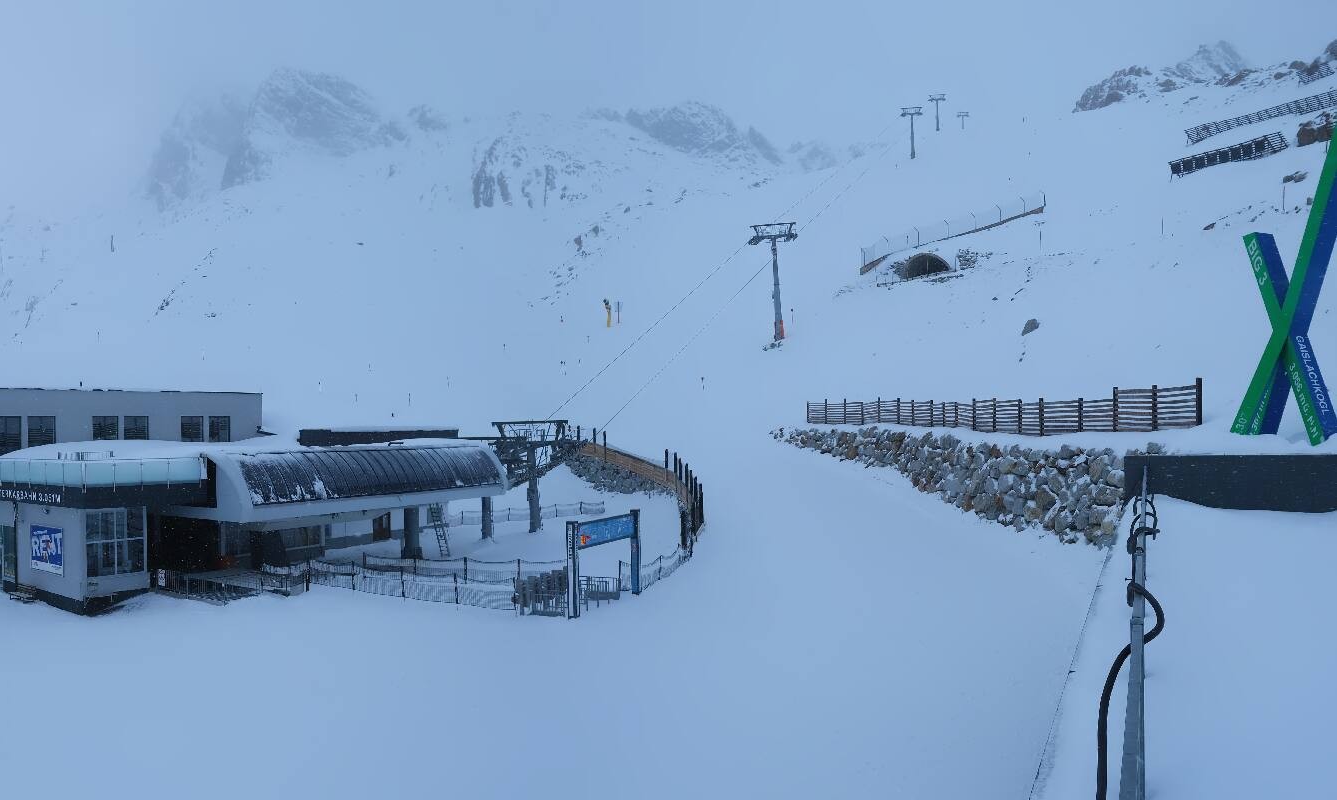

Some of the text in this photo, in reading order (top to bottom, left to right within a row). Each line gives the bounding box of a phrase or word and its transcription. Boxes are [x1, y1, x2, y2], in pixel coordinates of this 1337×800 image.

[1247, 238, 1268, 286] BIG 3
[1295, 335, 1330, 416] GAISLACHKOGL
[31, 533, 62, 557] RENT
